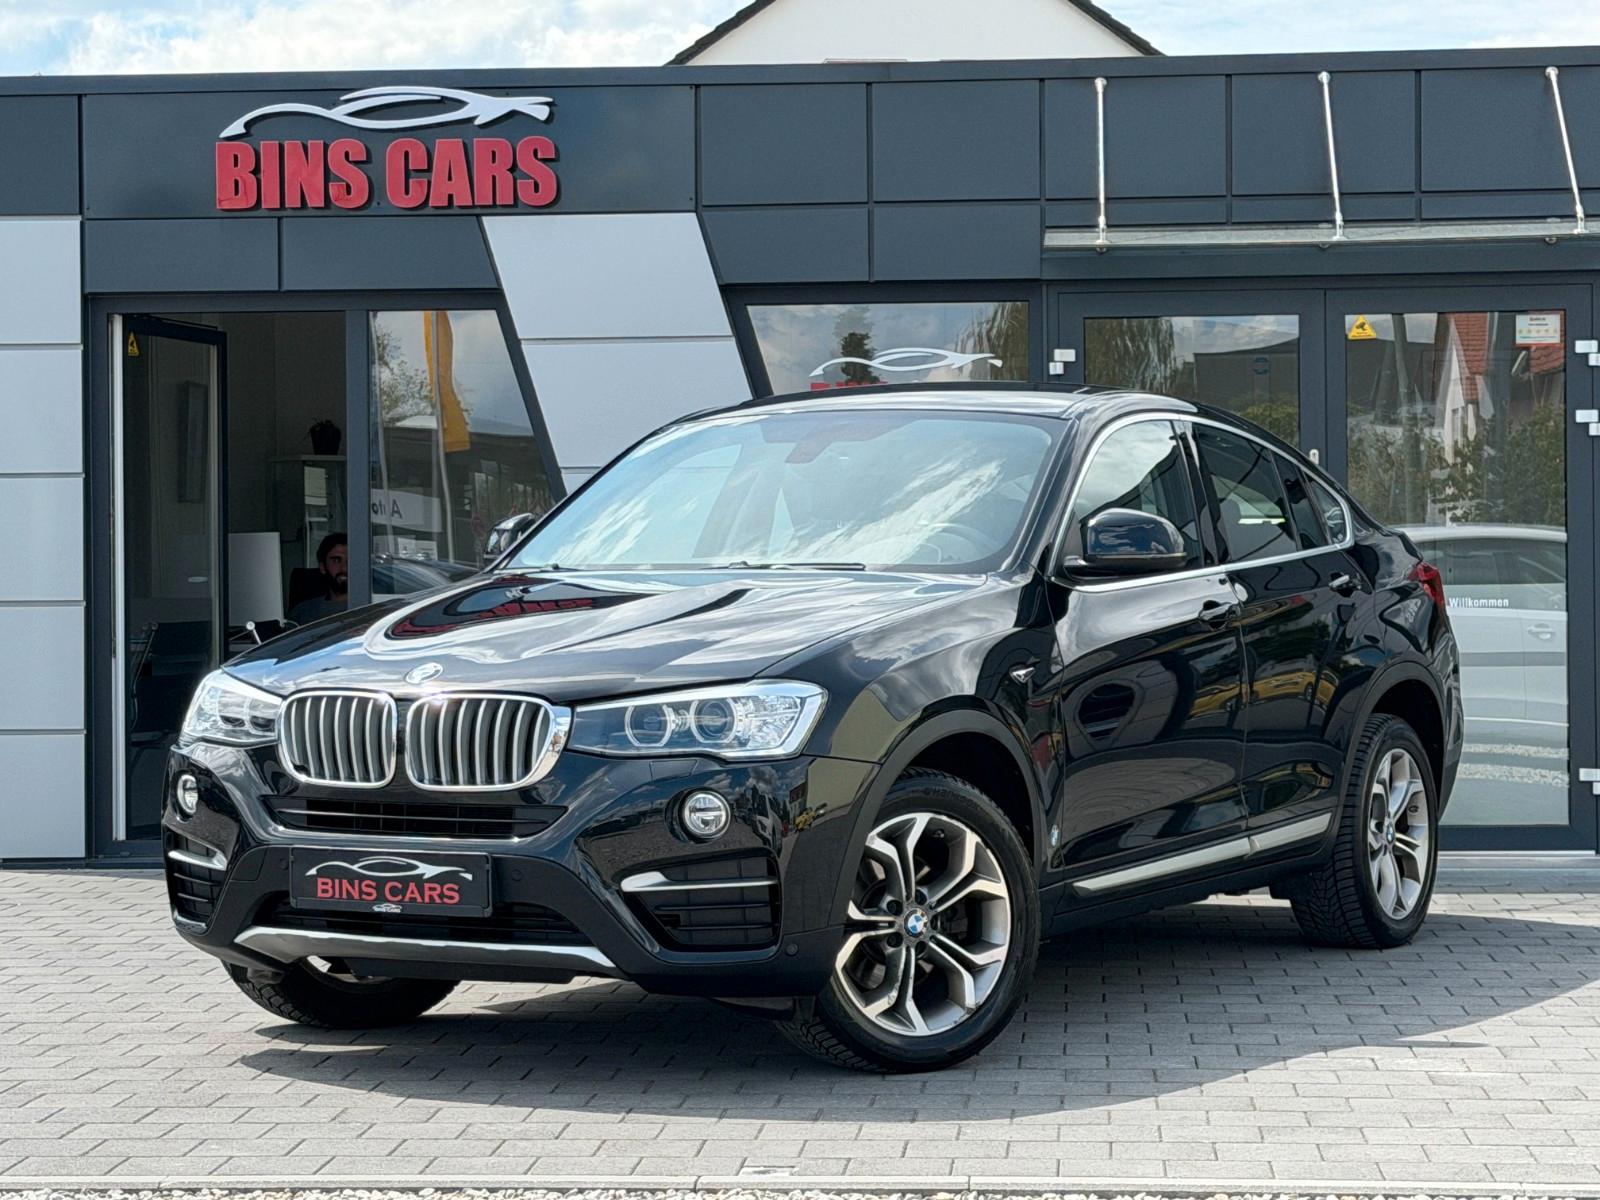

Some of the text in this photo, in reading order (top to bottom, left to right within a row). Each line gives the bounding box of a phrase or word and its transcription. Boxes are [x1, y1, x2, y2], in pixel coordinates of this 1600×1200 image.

[215, 136, 557, 209] BINS CARS
[1448, 597, 1509, 608] Willkommen
[316, 877, 460, 904] BINS CARS
